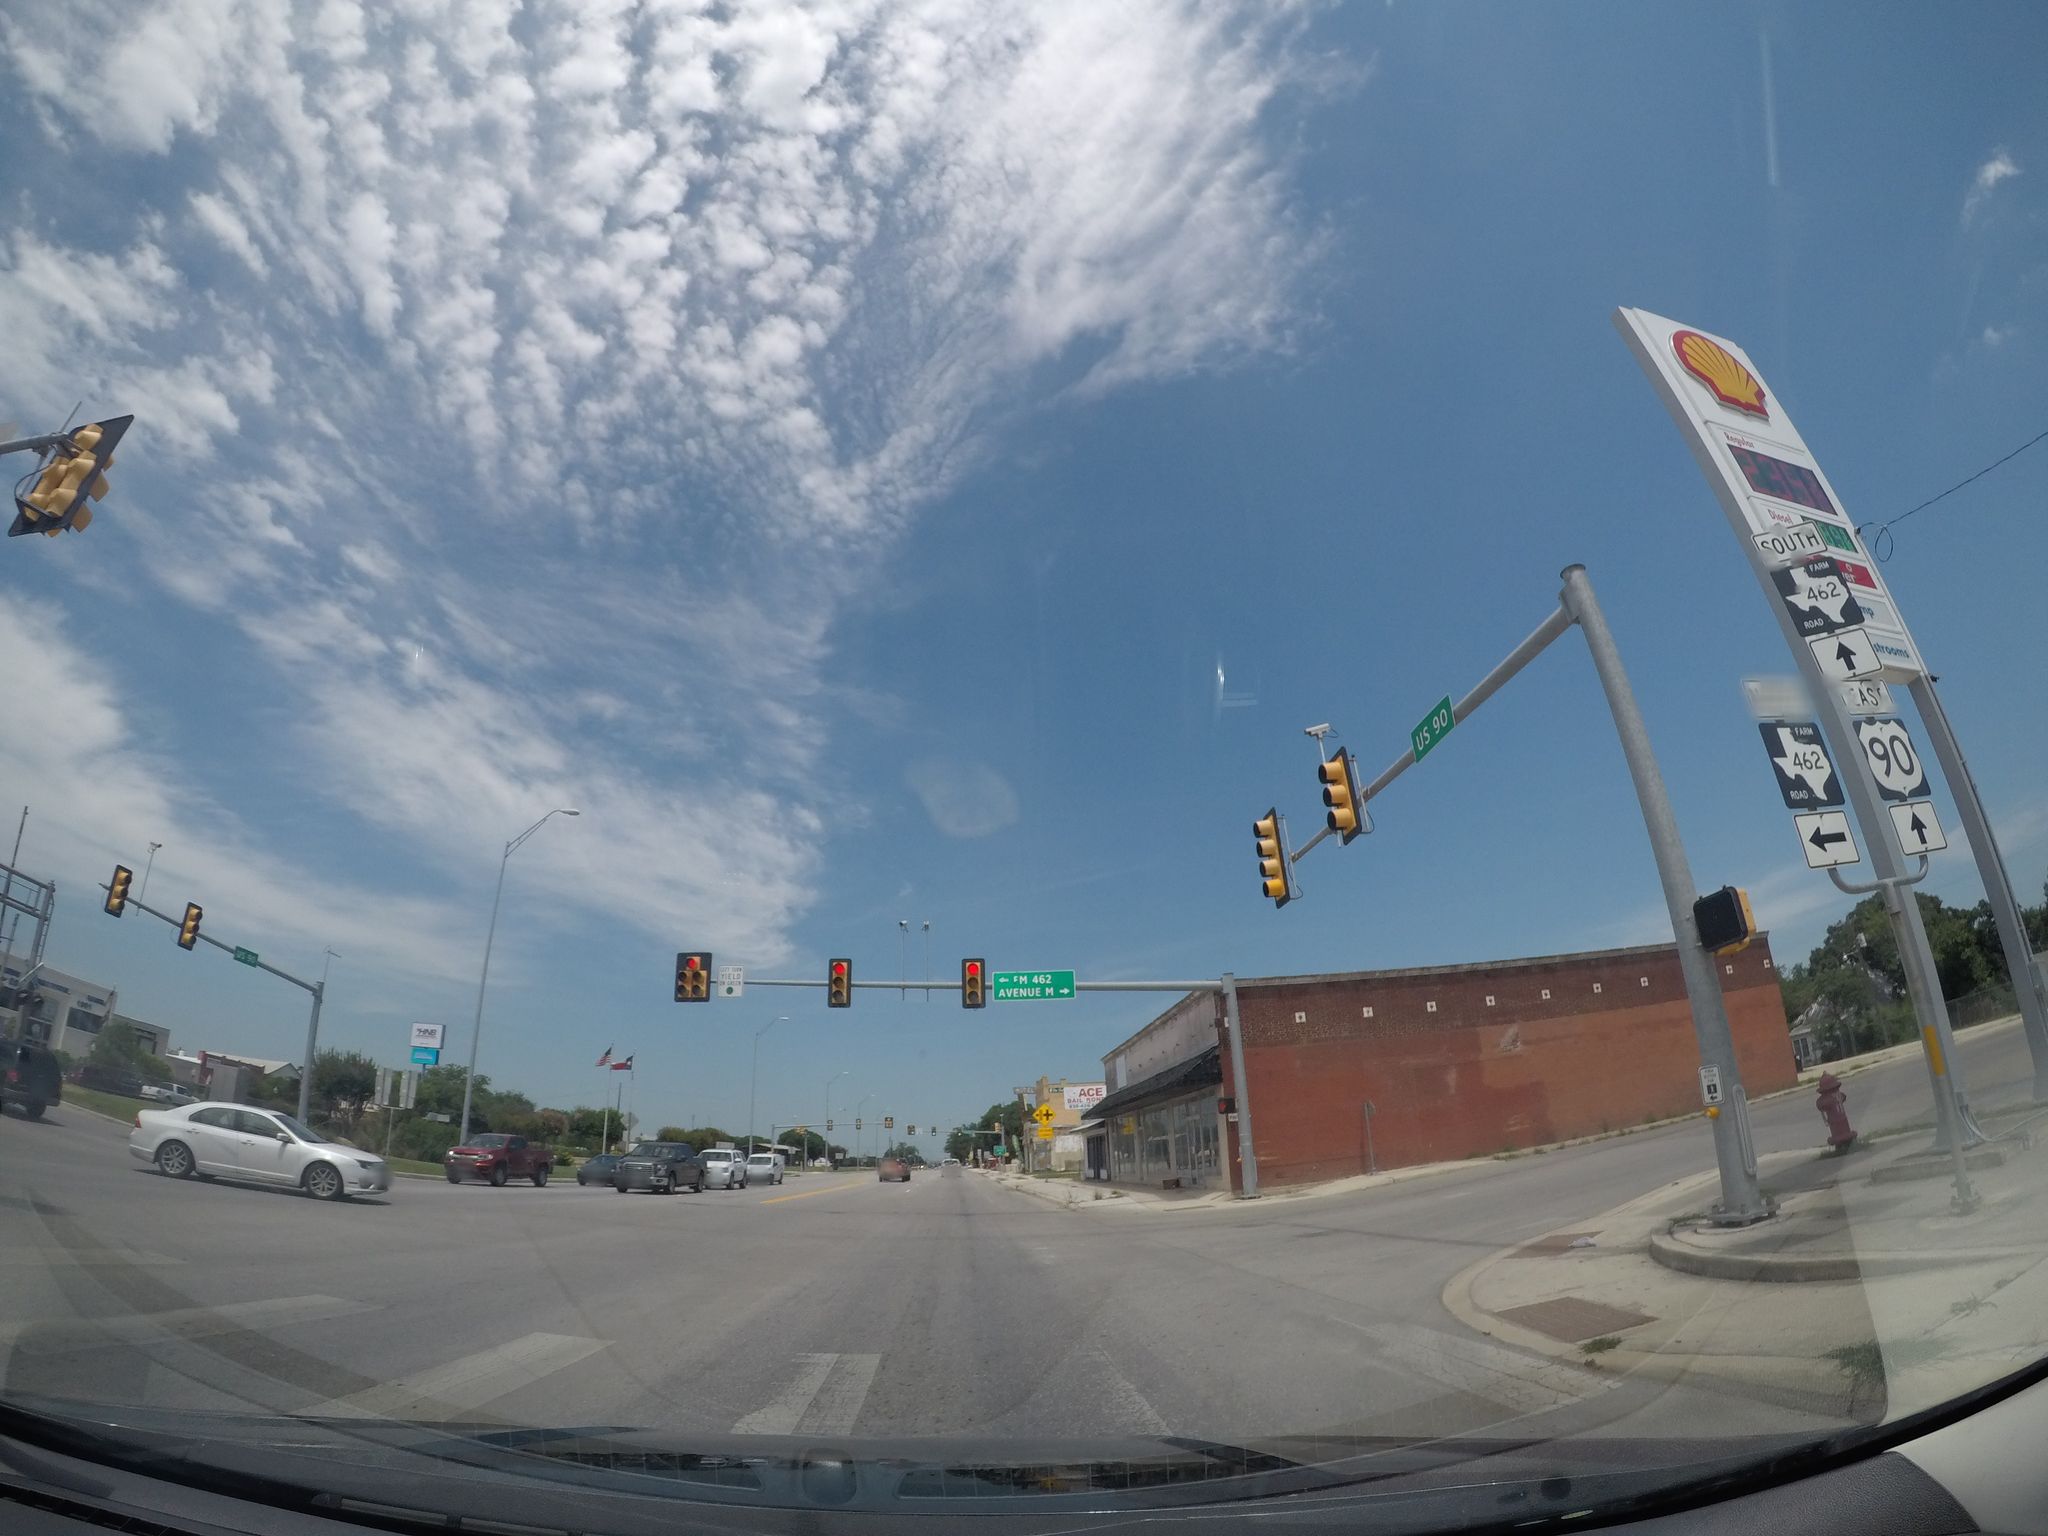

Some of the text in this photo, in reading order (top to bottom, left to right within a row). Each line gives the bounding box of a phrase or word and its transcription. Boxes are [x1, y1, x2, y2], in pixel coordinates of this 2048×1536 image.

[1767, 508, 1794, 525] Diesel
[1808, 561, 1830, 572] FARM
[1807, 582, 1841, 602] 462
[1803, 618, 1824, 630] ROAD
[1415, 708, 1448, 751] US 90
[1794, 727, 1814, 736] FARM
[1793, 751, 1825, 771] 462
[1868, 735, 1915, 779] 90
[1789, 789, 1809, 800] ROAD
[1032, 974, 1052, 984] 462
[998, 987, 1054, 998] AVENUE M
[1078, 1087, 1103, 1097] ACE
